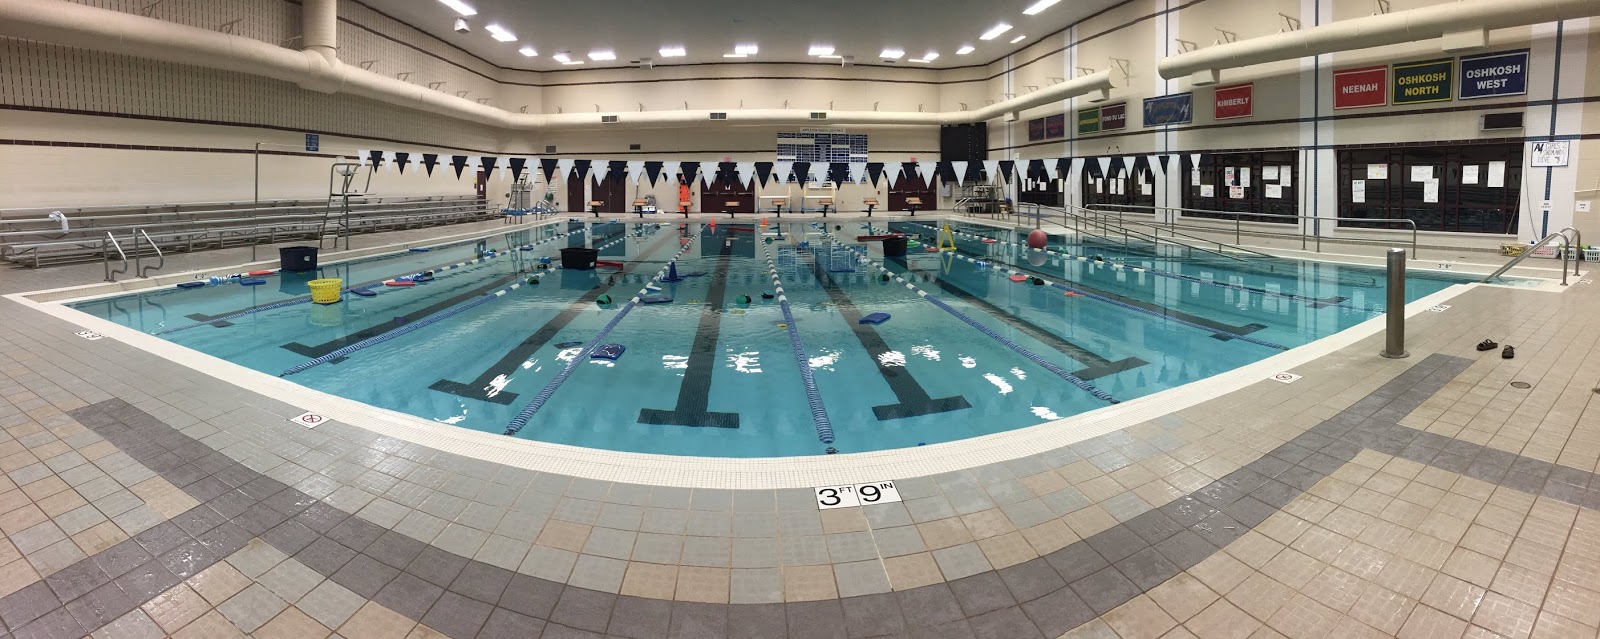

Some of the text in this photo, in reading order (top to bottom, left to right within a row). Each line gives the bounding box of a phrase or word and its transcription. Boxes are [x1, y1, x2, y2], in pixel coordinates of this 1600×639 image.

[1466, 64, 1521, 79] OSHKOSH
[1398, 72, 1447, 86] OSHKOSH
[1476, 78, 1508, 90] WEST
[1342, 83, 1378, 95] NEENAH
[1404, 86, 1439, 97] NORTH
[1217, 97, 1250, 108] KIMBERLY
